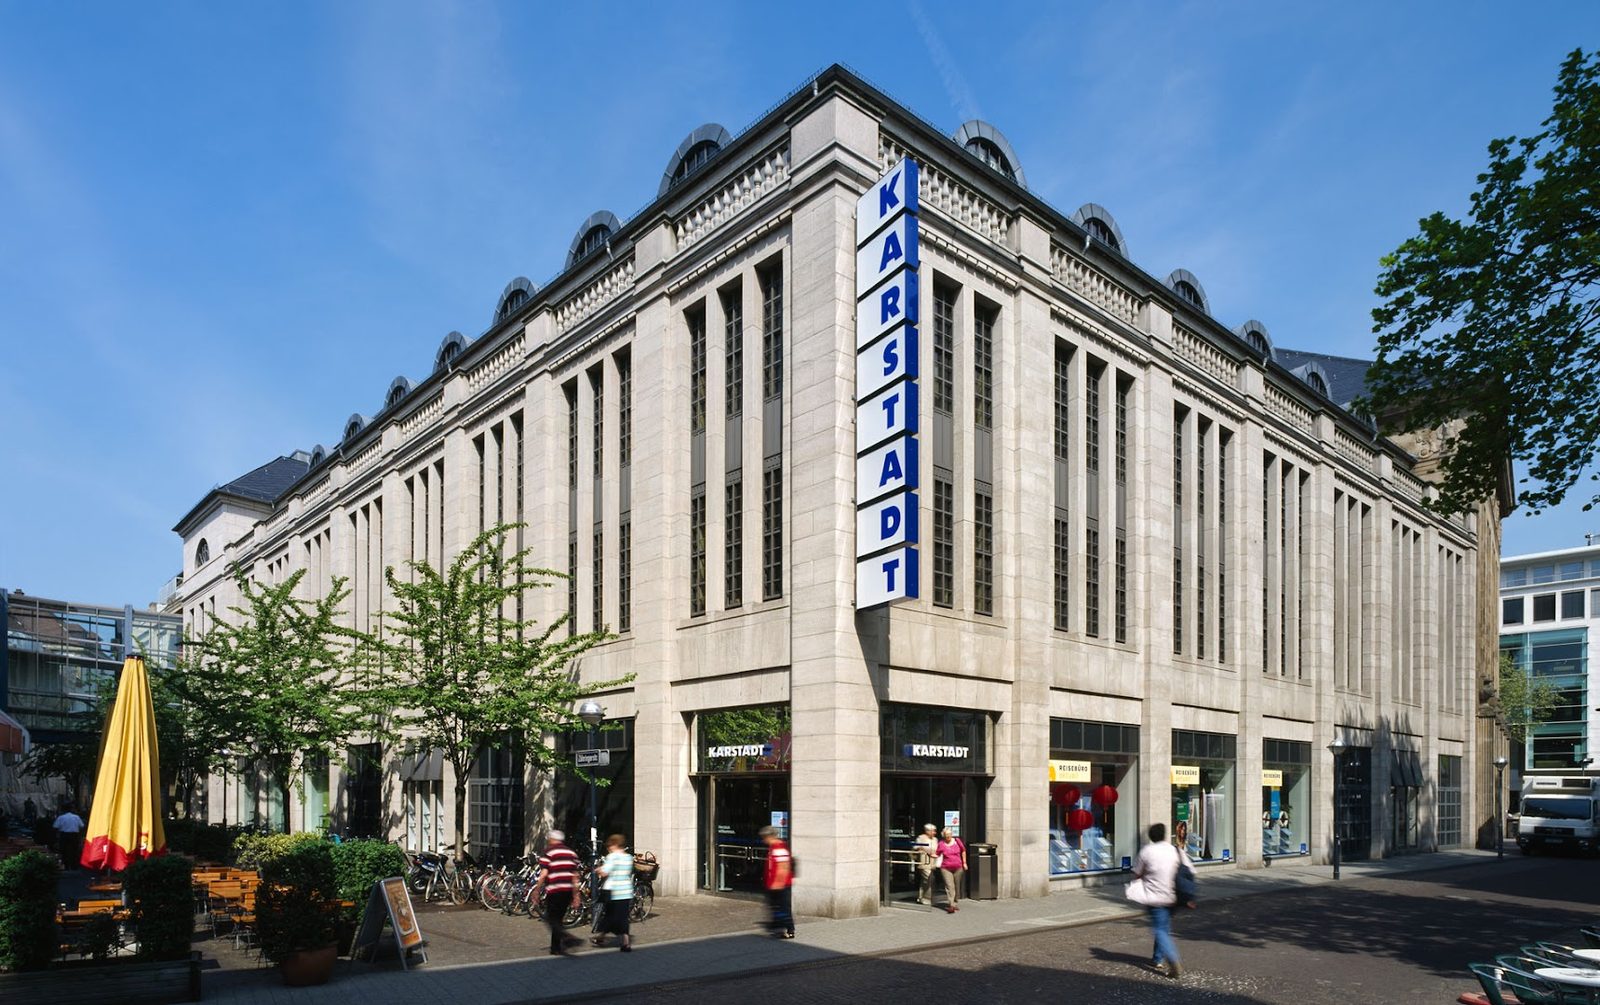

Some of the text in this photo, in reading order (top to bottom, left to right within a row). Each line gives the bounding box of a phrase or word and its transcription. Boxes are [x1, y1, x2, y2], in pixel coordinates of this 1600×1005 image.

[879, 169, 903, 593] KARSTADT
[708, 744, 765, 758] KARSTADT
[912, 744, 969, 759] KARSTADT
[1059, 764, 1088, 773] REISEBÜRO
